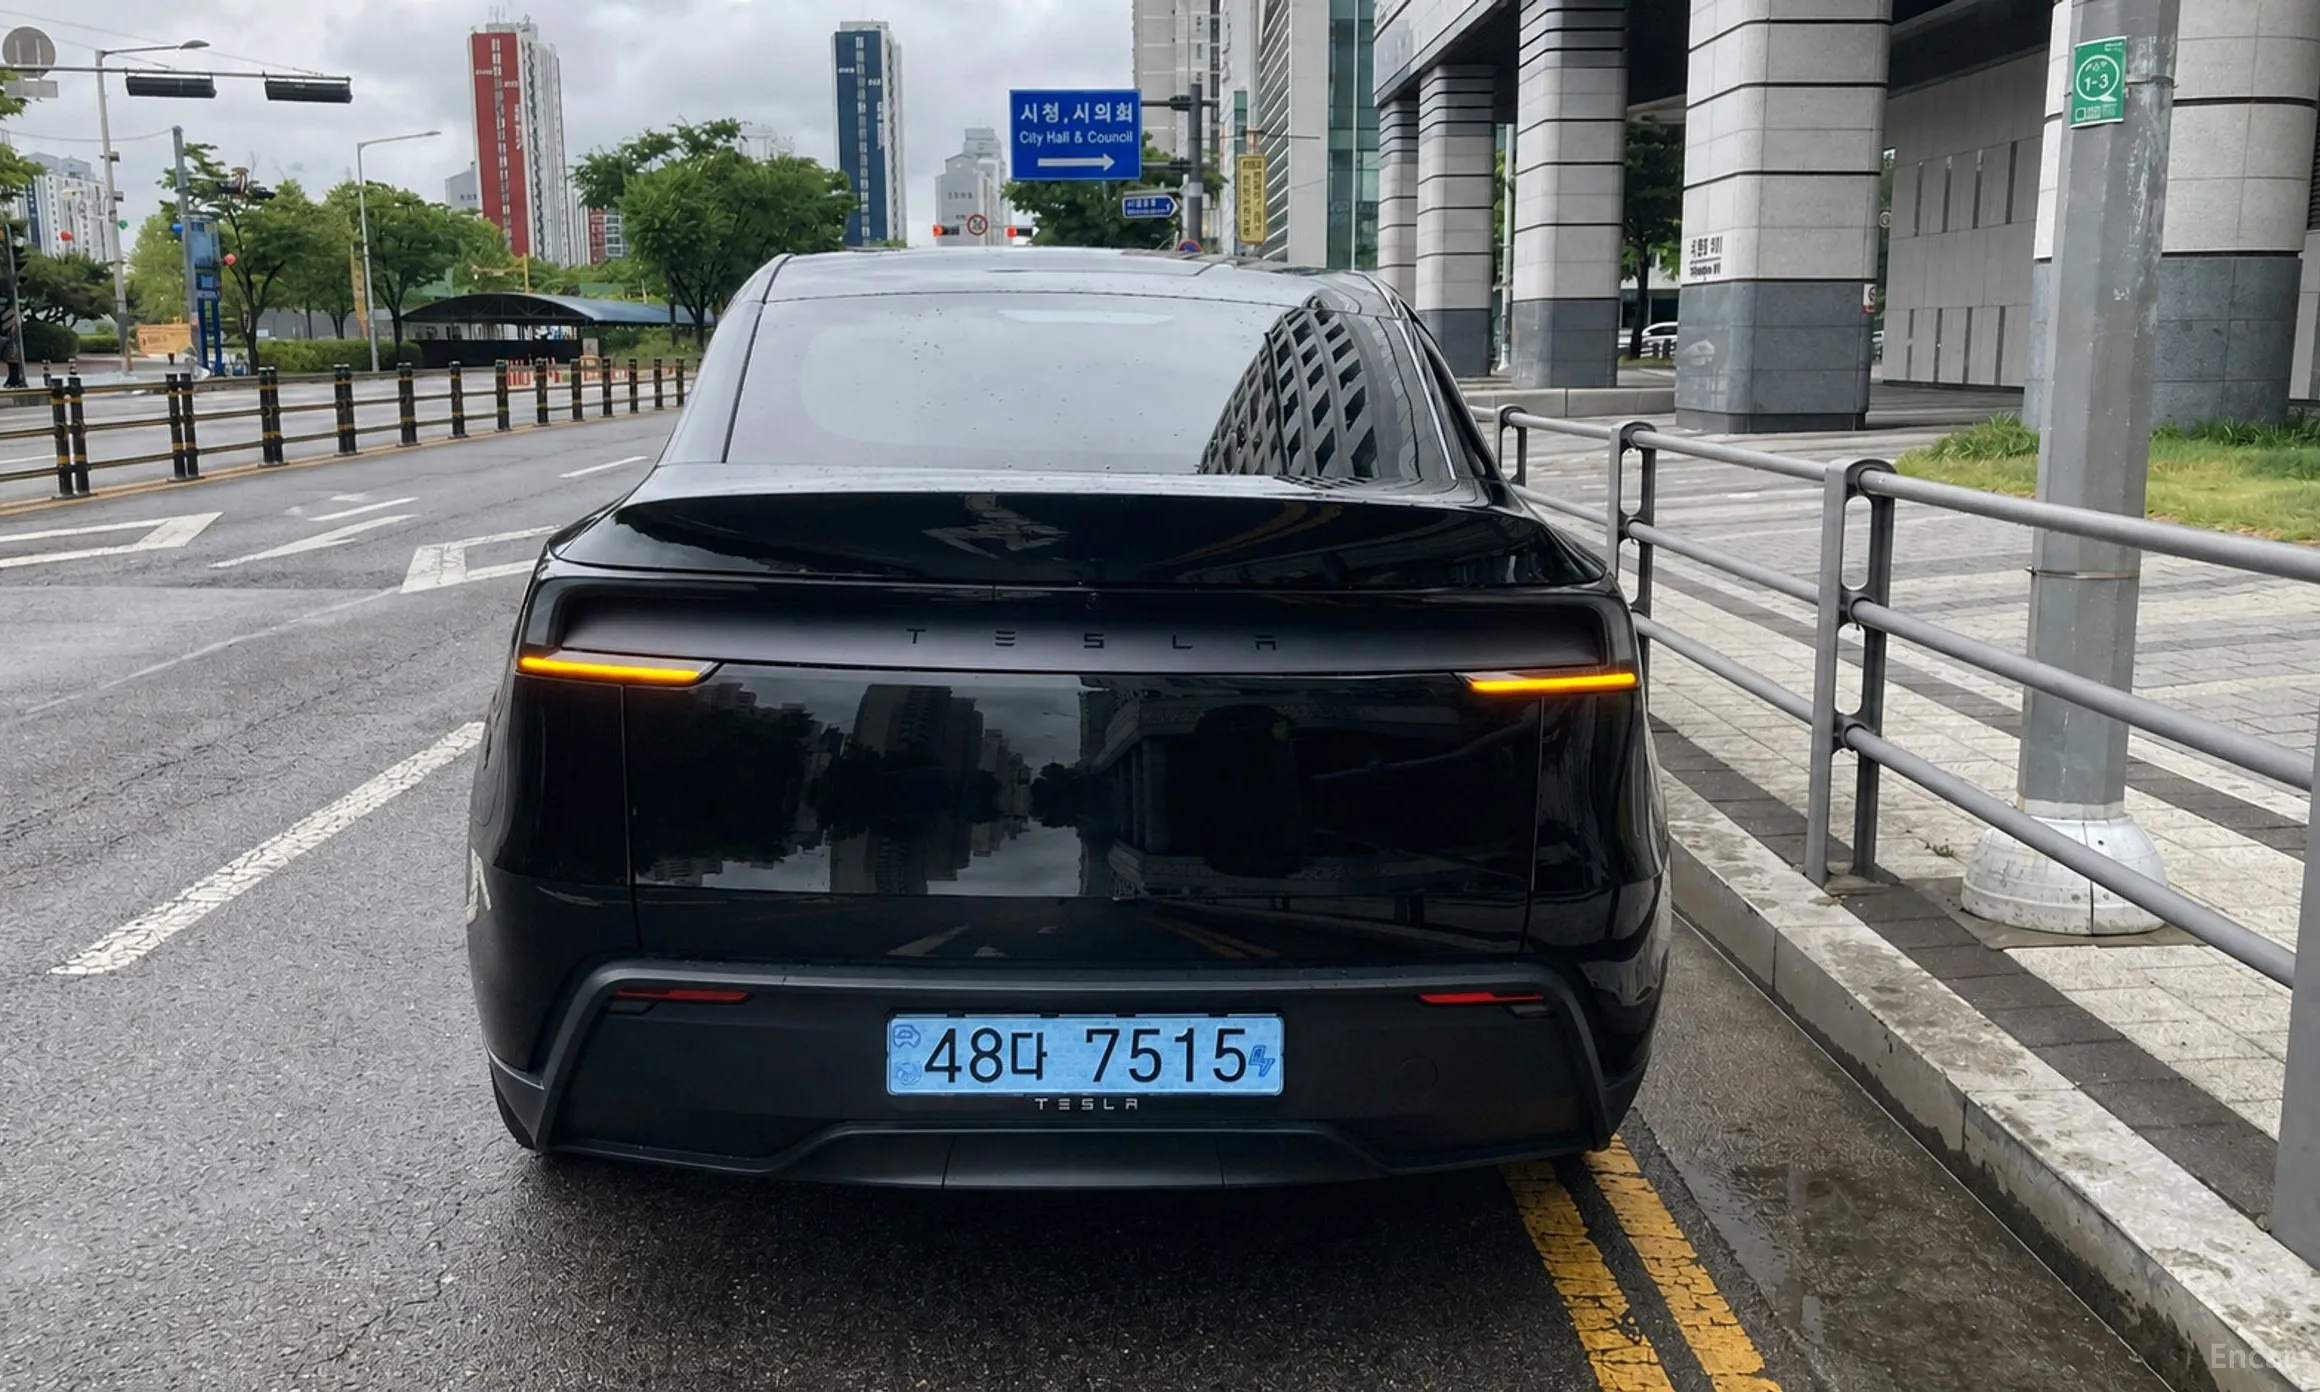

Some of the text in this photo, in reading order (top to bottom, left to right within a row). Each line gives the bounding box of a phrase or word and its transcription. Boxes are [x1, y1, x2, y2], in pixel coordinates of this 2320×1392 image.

[2083, 73, 2109, 91] 1-3
[1019, 130, 1133, 147] City Hall & Council
[906, 628, 1277, 651] TESLA
[924, 1028, 1048, 1083] 48다
[1085, 1028, 1246, 1083] 7515
[1034, 1097, 1138, 1110] TESLA
